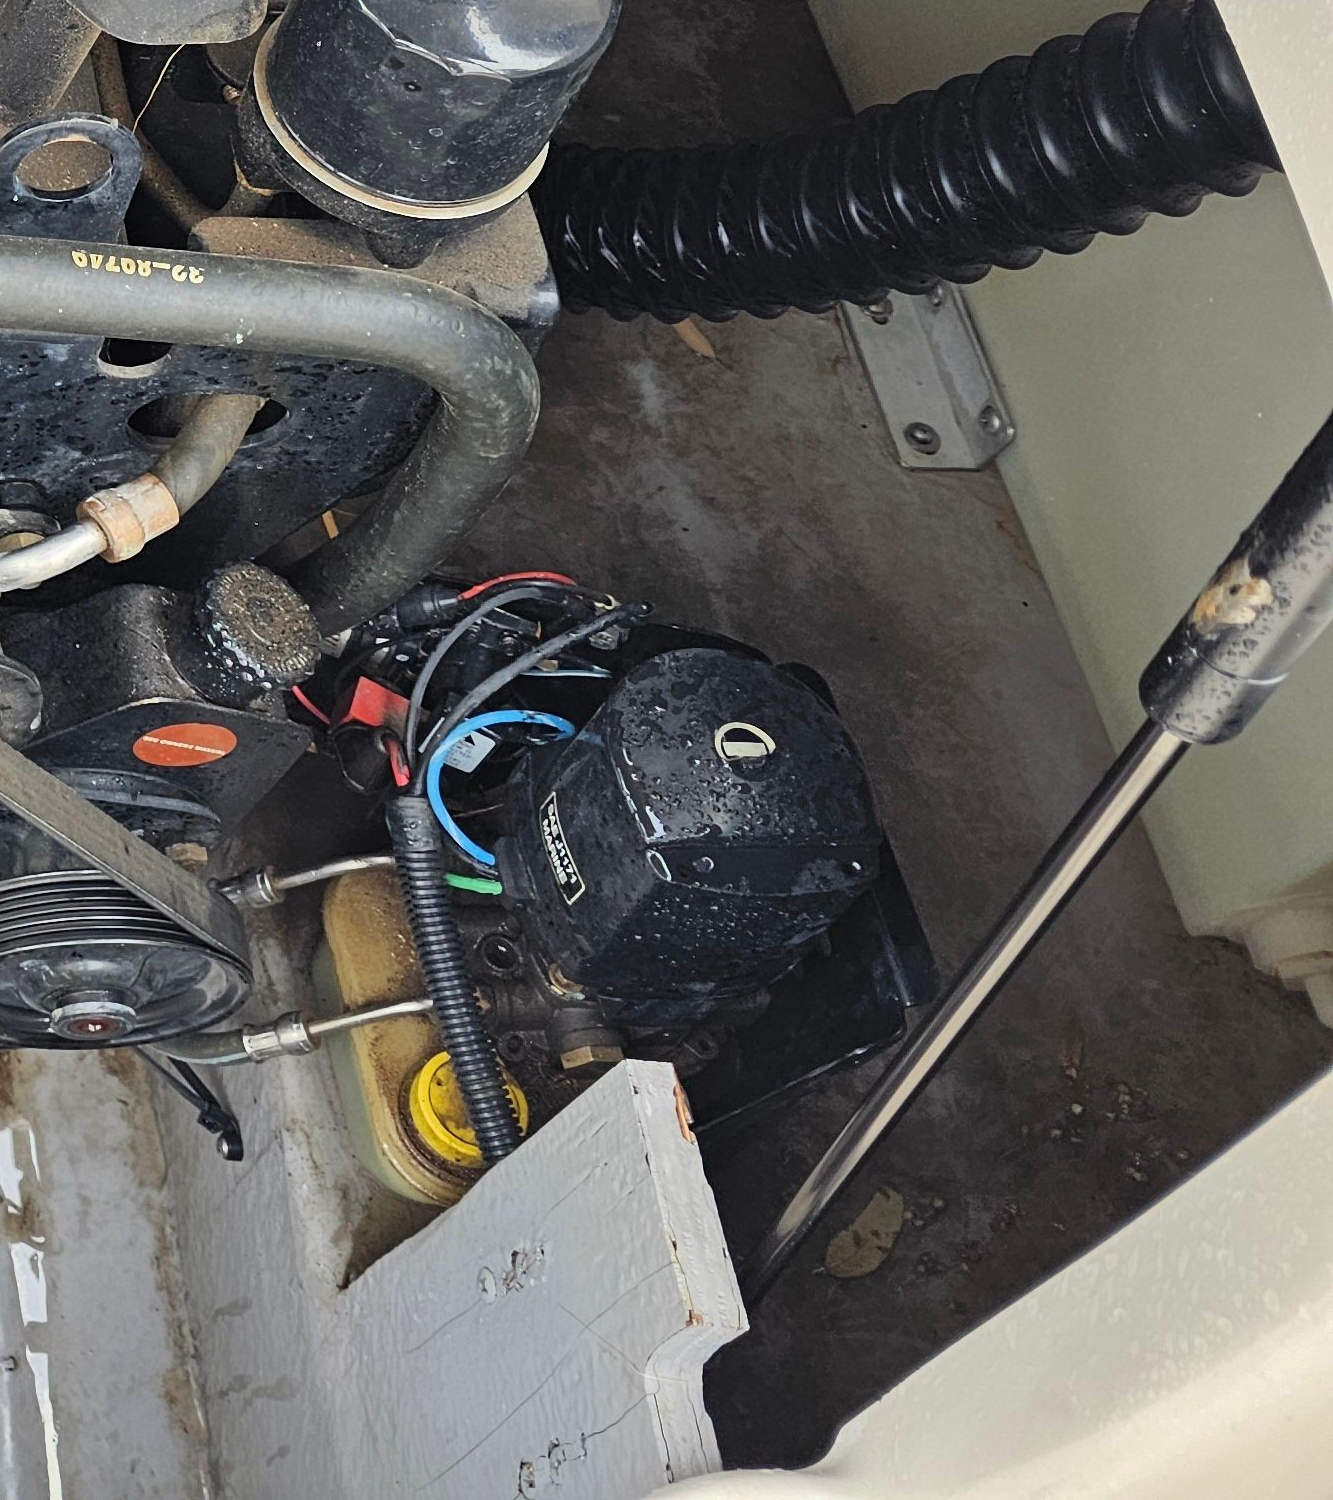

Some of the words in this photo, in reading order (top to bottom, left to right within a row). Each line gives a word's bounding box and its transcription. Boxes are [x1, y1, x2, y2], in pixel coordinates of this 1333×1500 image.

[543, 819, 568, 885] MARINE
[548, 804, 559, 838] SAE
[555, 839, 577, 884] J1171
